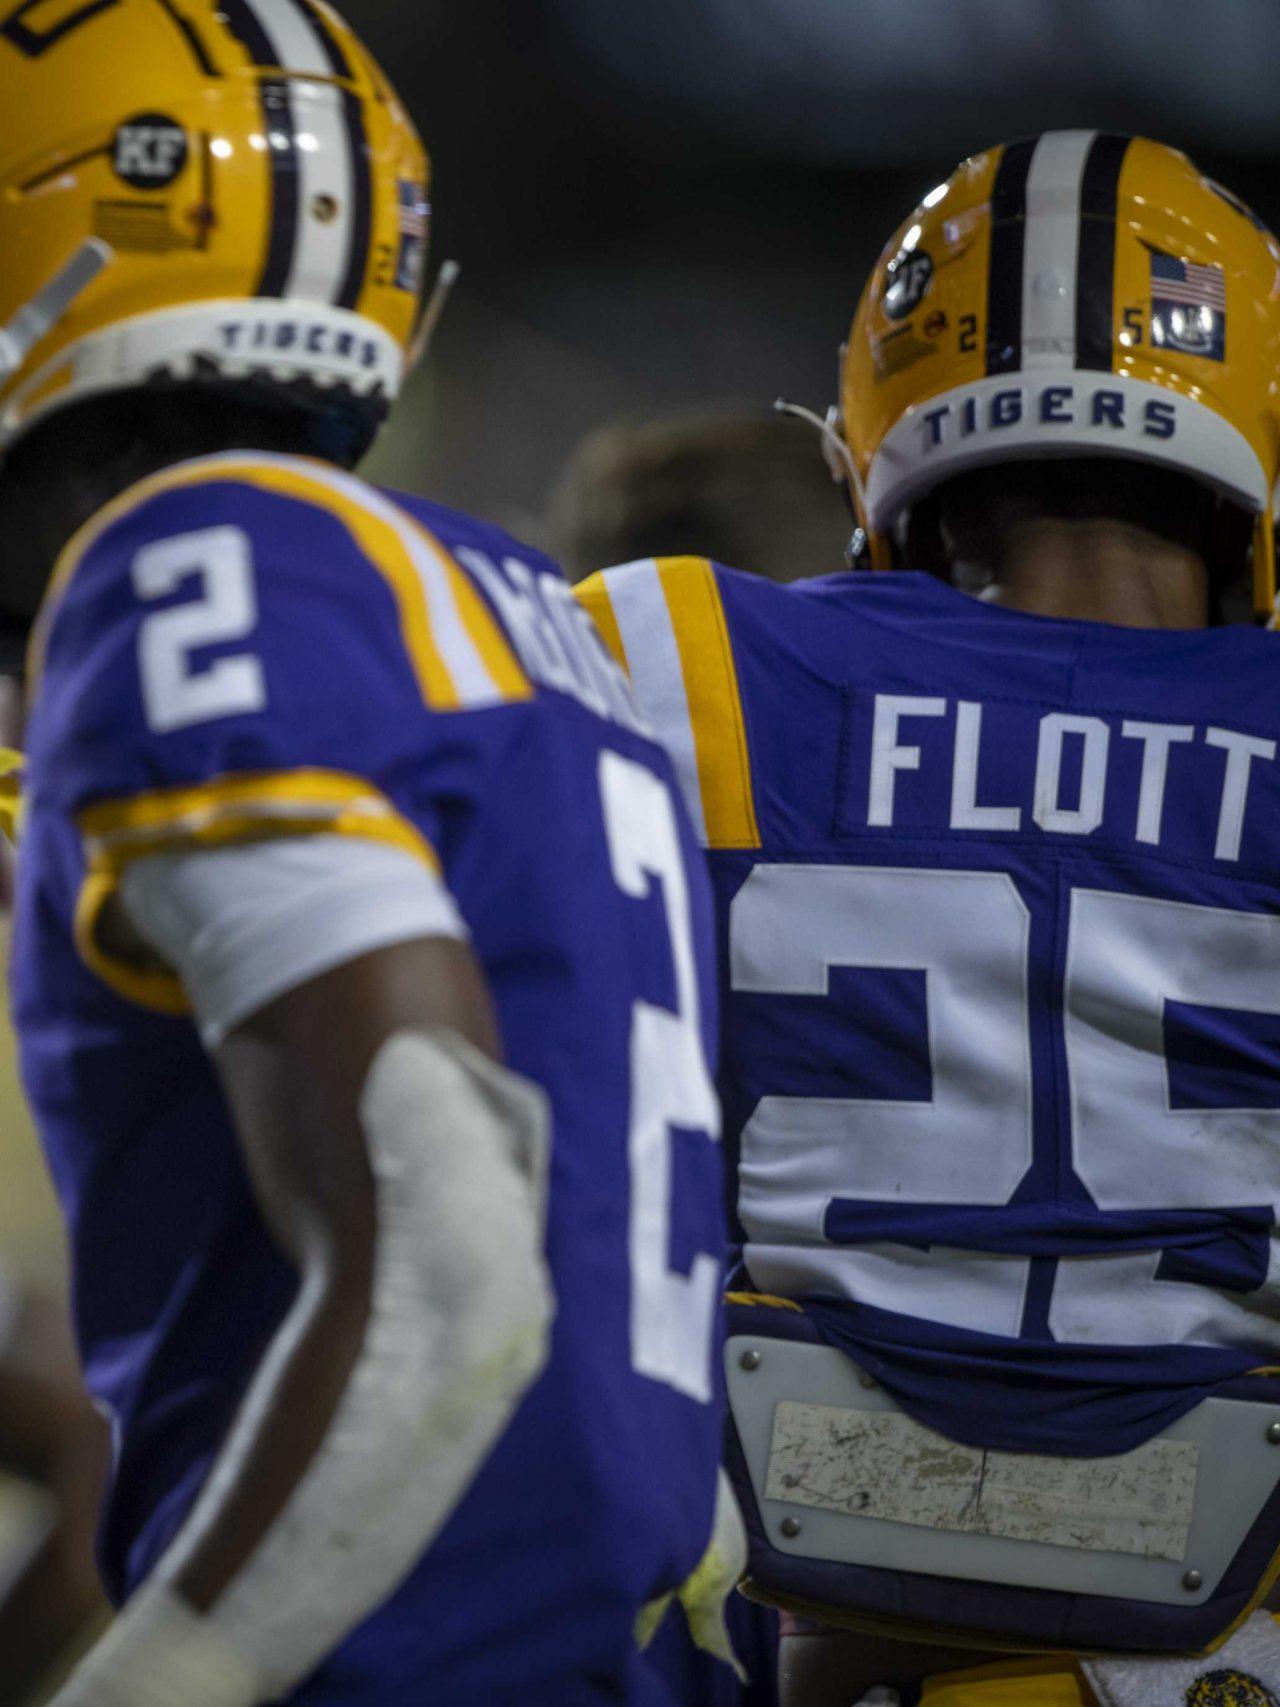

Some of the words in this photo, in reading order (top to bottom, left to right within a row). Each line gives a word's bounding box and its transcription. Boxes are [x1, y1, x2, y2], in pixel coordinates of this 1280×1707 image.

[222, 319, 378, 368] TIGERS
[924, 387, 1178, 445] TIGERS
[131, 524, 265, 733] 2
[867, 694, 1276, 862] FLOTT
[729, 863, 1280, 1345] 25
